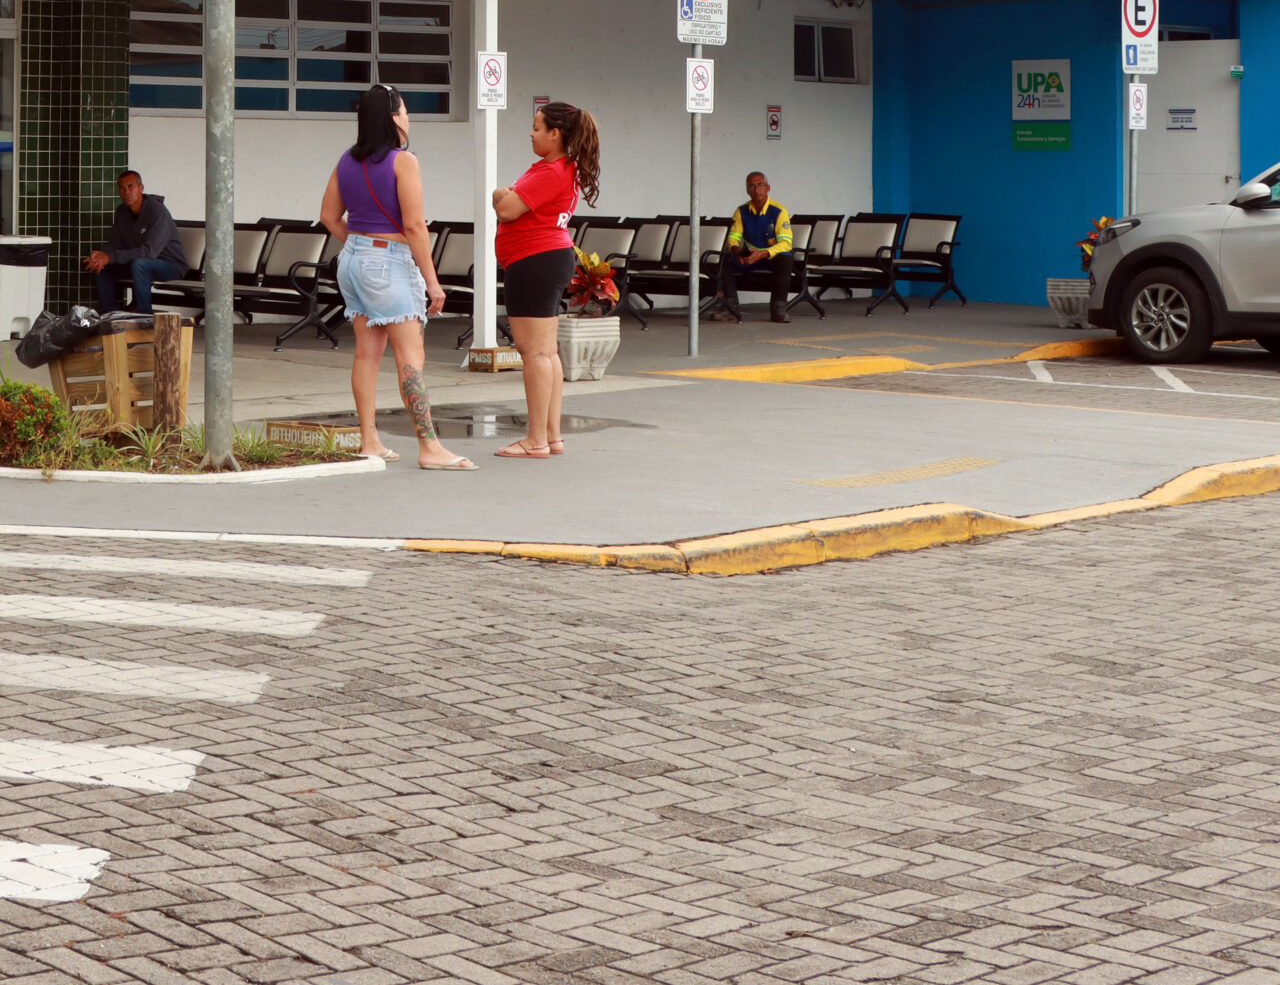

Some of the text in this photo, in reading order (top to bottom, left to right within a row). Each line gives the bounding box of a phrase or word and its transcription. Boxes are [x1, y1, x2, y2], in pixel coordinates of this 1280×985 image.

[694, 1, 722, 9] EXCLUSIVO
[694, 7, 724, 15] DEFICIENTE
[1017, 72, 1064, 93] UPA
[1017, 94, 1040, 108] 24h
[470, 352, 492, 364] PMSS
[334, 432, 361, 448] PMSS
